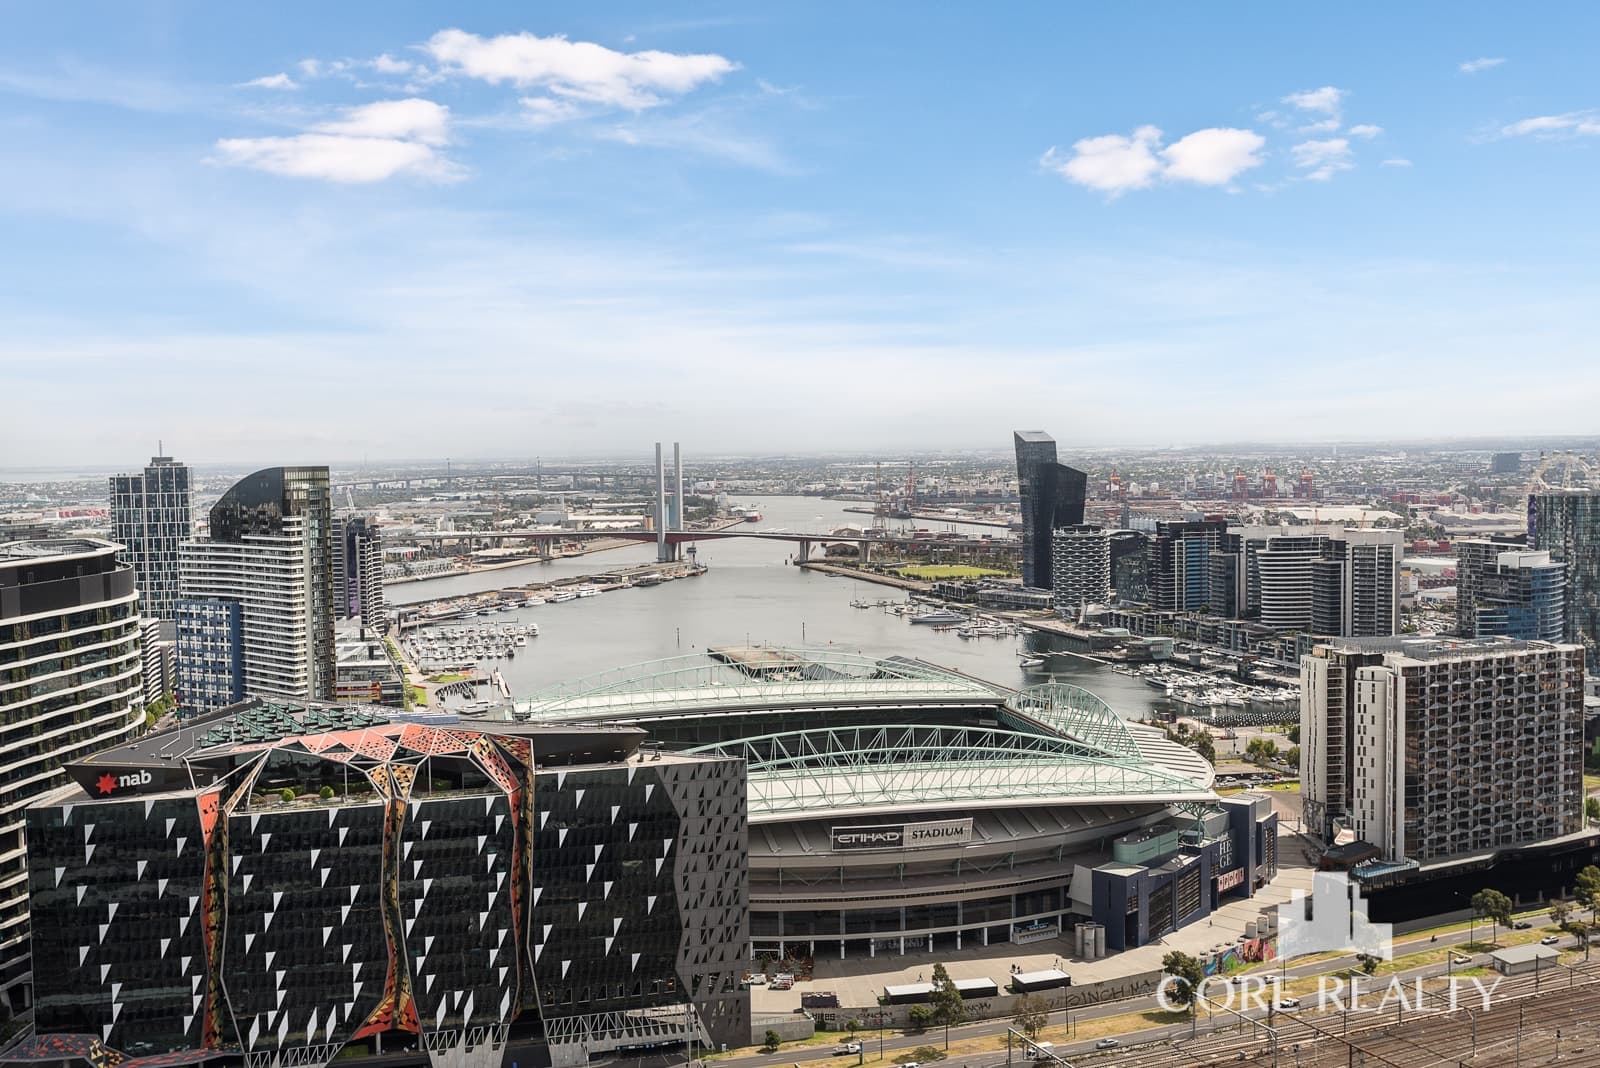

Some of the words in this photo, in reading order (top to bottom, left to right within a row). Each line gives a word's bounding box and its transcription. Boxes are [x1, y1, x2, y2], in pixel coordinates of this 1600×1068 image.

[119, 770, 152, 787] nab
[837, 831, 900, 843] ETIHAD
[912, 827, 964, 839] STADIUM
